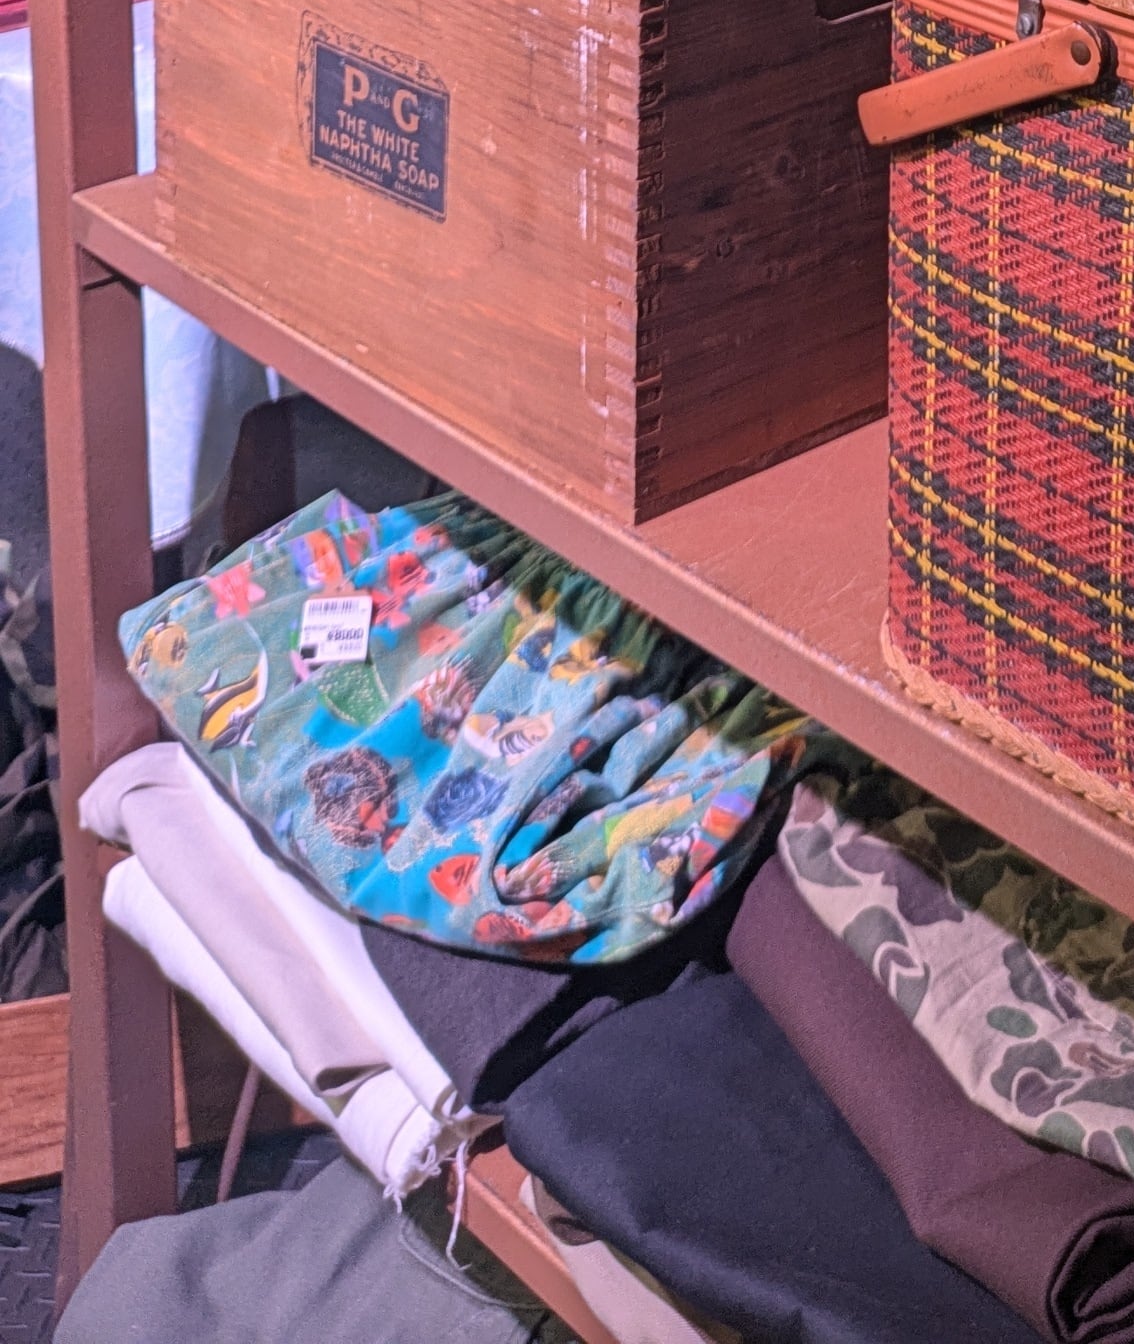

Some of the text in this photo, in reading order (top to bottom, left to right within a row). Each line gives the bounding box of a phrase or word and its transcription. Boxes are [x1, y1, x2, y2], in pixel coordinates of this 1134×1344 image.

[343, 63, 370, 108] P
[393, 88, 420, 134] G
[319, 124, 393, 174] NAPHTHA
[397, 159, 440, 191] SOAP
[337, 109, 421, 164] THE WHITE
